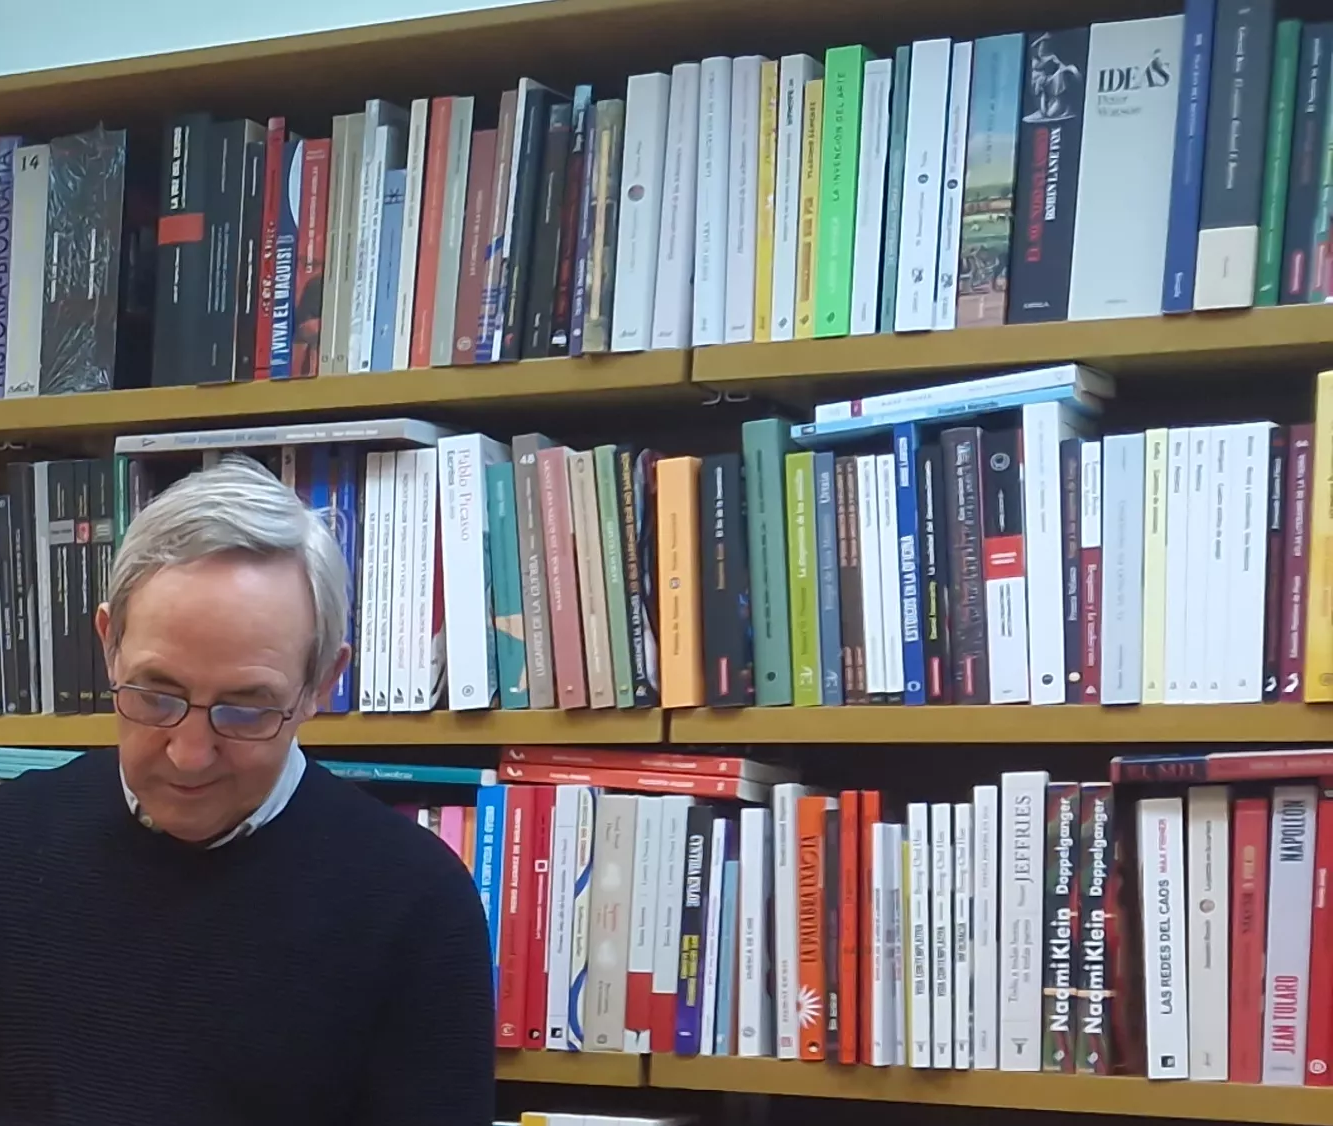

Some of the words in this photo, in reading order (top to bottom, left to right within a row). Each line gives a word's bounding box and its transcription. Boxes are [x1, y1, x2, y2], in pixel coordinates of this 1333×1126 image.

[835, 72, 847, 100] ARTE
[832, 125, 845, 186] INVENCIÓN
[1048, 127, 1062, 150] FOX
[1047, 151, 1060, 181] LANE
[1044, 183, 1058, 221] ROBIN
[273, 247, 293, 299] MAQUIS!
[457, 450, 472, 487] Pablo
[458, 492, 472, 541] Picasso
[1013, 795, 1034, 884] JEFFRIES
[1055, 796, 1074, 895] Doppelganger
[1089, 798, 1107, 897] Doppelganger
[1277, 800, 1306, 862] NAPOLEÓN
[799, 894, 819, 946] PALABRA
[1158, 879, 1170, 914] CAOS
[1050, 907, 1072, 959] Klein
[1084, 909, 1105, 961] Klein
[1159, 917, 1171, 941] DEL
[1159, 944, 1172, 987] REDES
[1049, 961, 1071, 1031] Naomi
[1082, 963, 1104, 1034] Naomi
[1159, 990, 1173, 1015] LAS
[1273, 975, 1299, 1020] TULARD
[1272, 1025, 1296, 1054] JEAN
